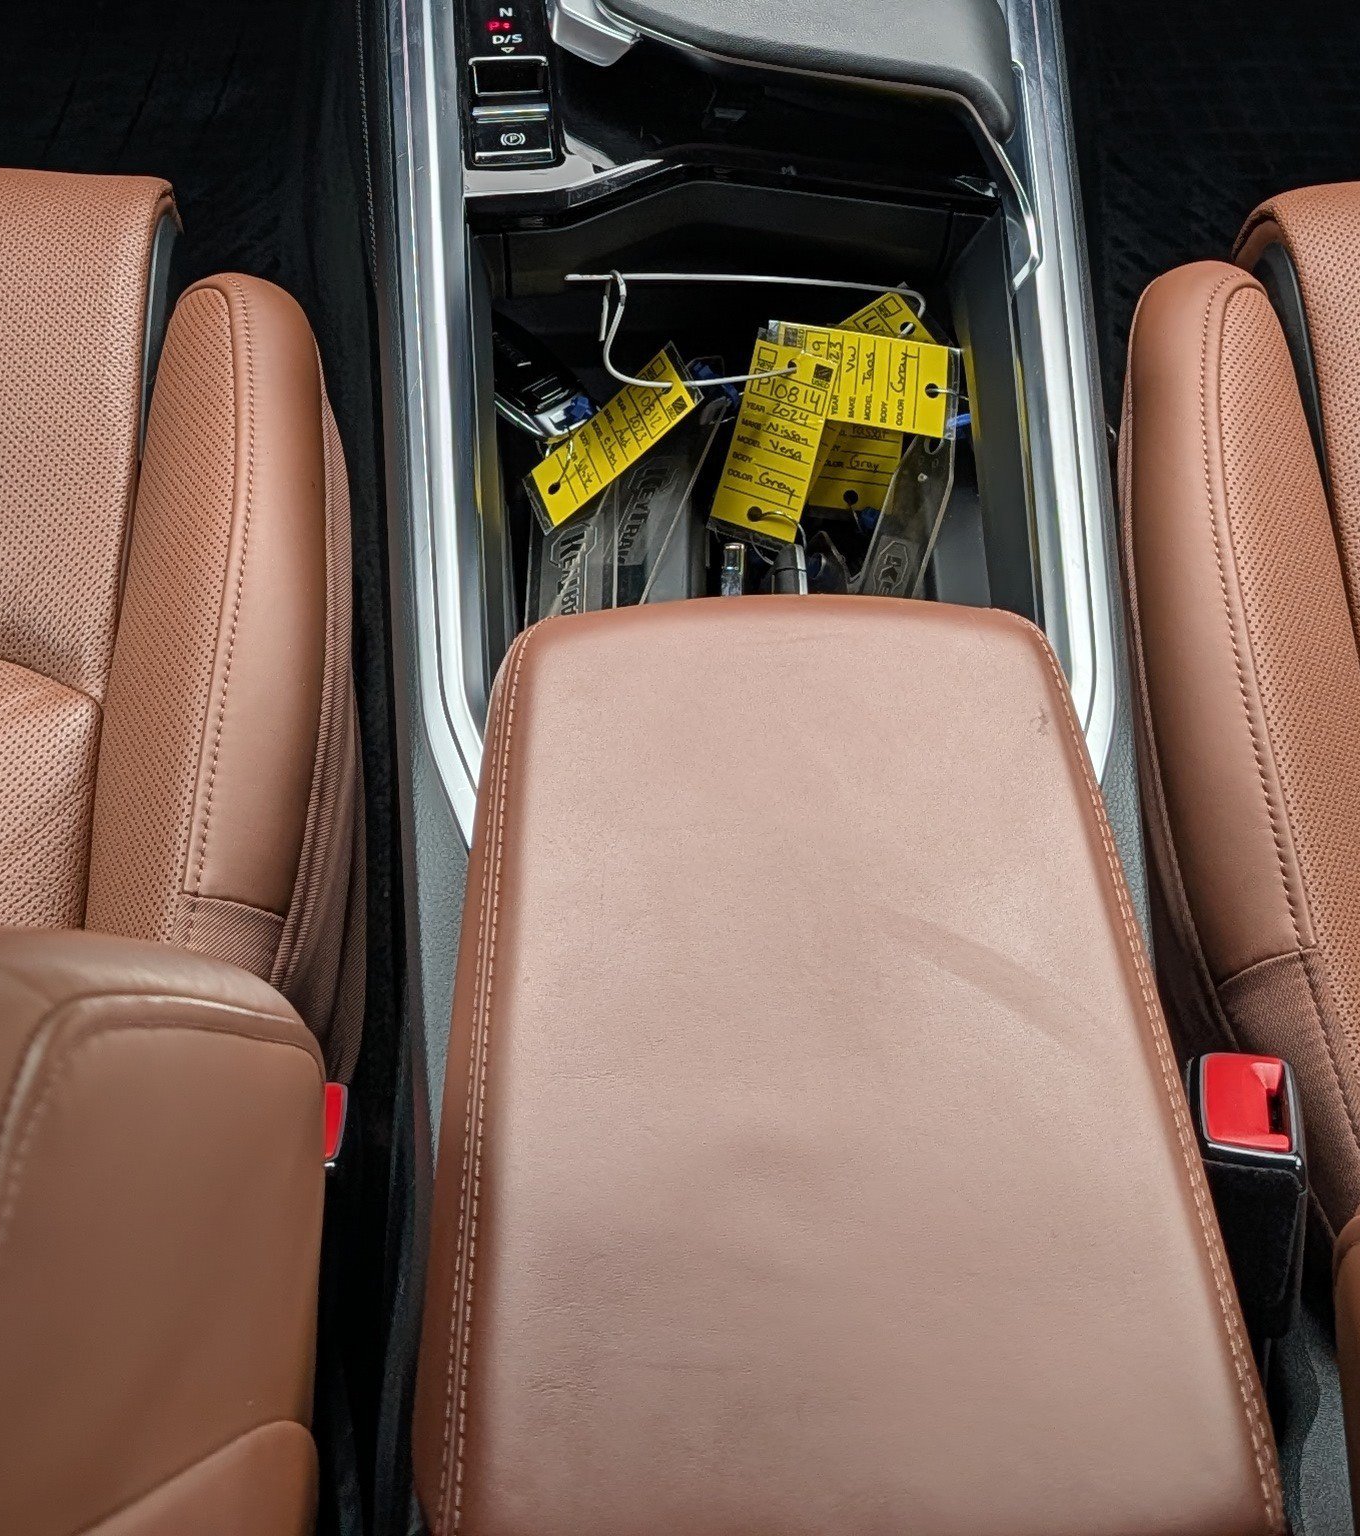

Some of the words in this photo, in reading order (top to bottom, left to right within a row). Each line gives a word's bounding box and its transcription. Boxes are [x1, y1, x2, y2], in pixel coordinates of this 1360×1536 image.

[499, 7, 513, 17] N
[492, 33, 523, 45] D/S
[845, 346, 857, 373] VW
[862, 352, 875, 386] Taos
[890, 350, 918, 393] Gray
[756, 373, 822, 413] P10814
[811, 378, 830, 389] USED
[632, 386, 663, 430] 10812
[745, 400, 766, 414] YEAR
[772, 403, 810, 427] 2024
[830, 394, 839, 415] YEAR
[847, 395, 856, 418] MAKE
[863, 393, 873, 421] MODEL
[879, 400, 889, 424] BODY
[895, 398, 905, 426] COLOR
[629, 415, 648, 441] 2023
[741, 418, 762, 431] MAKE
[767, 421, 810, 445] Nissan
[732, 451, 753, 464] BODY
[736, 434, 762, 449] MODEL
[769, 439, 804, 461] Versa
[727, 468, 753, 482] COLOR
